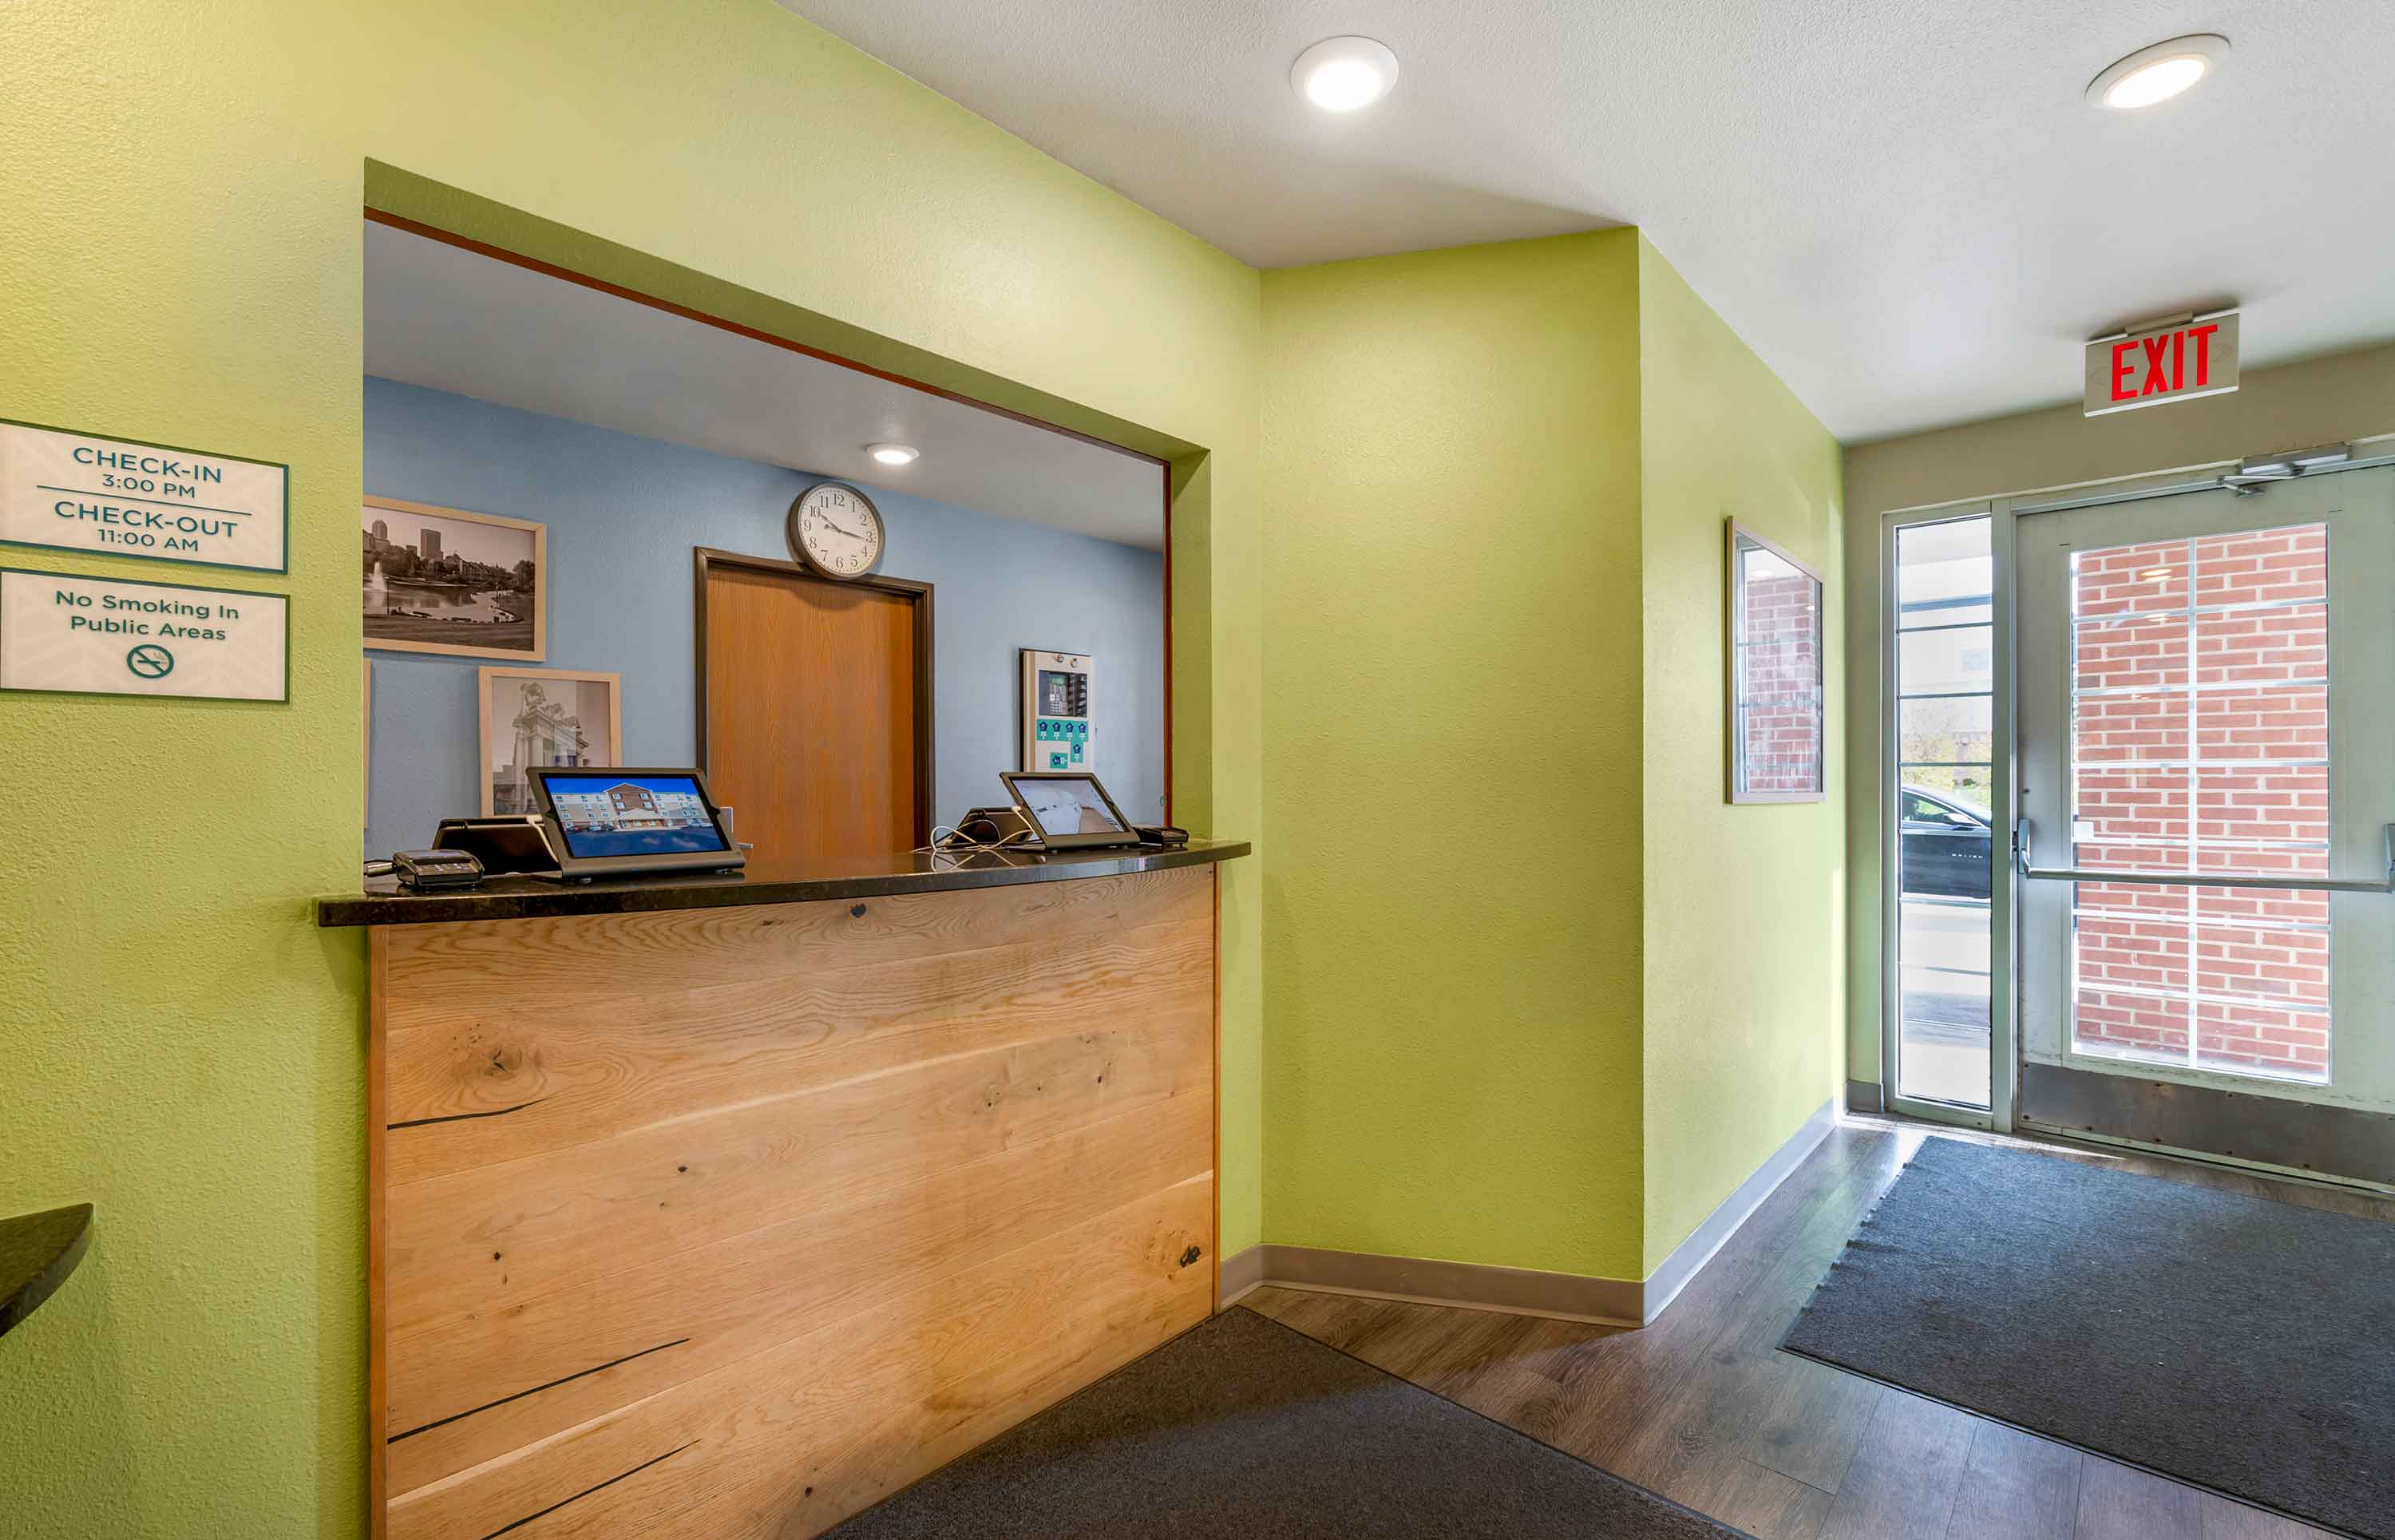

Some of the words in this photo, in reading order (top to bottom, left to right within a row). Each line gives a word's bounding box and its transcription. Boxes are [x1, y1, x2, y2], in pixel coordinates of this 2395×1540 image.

[2112, 323, 2218, 402] EXIT
[73, 447, 222, 484] CHECK-IN
[102, 473, 155, 493] 3:00
[164, 482, 196, 499] PM
[820, 495, 829, 508] 11
[833, 493, 845, 507] 12
[810, 505, 821, 518] 10
[851, 501, 856, 513] 1
[54, 501, 238, 537] CHECK-OUT
[804, 520, 811, 531] 9
[860, 514, 868, 526] 2
[97, 529, 156, 548] 11:00
[164, 536, 199, 552] AM
[810, 536, 817, 549] 8
[865, 531, 873, 543] 3
[821, 549, 828, 562] 7
[862, 545, 868, 557] 4
[836, 556, 844, 569] 6
[850, 555, 858, 567] 5
[56, 590, 93, 608] No
[102, 594, 210, 620] Smoking
[219, 604, 240, 620] In
[70, 615, 149, 636] Public
[158, 622, 226, 641] Areas
